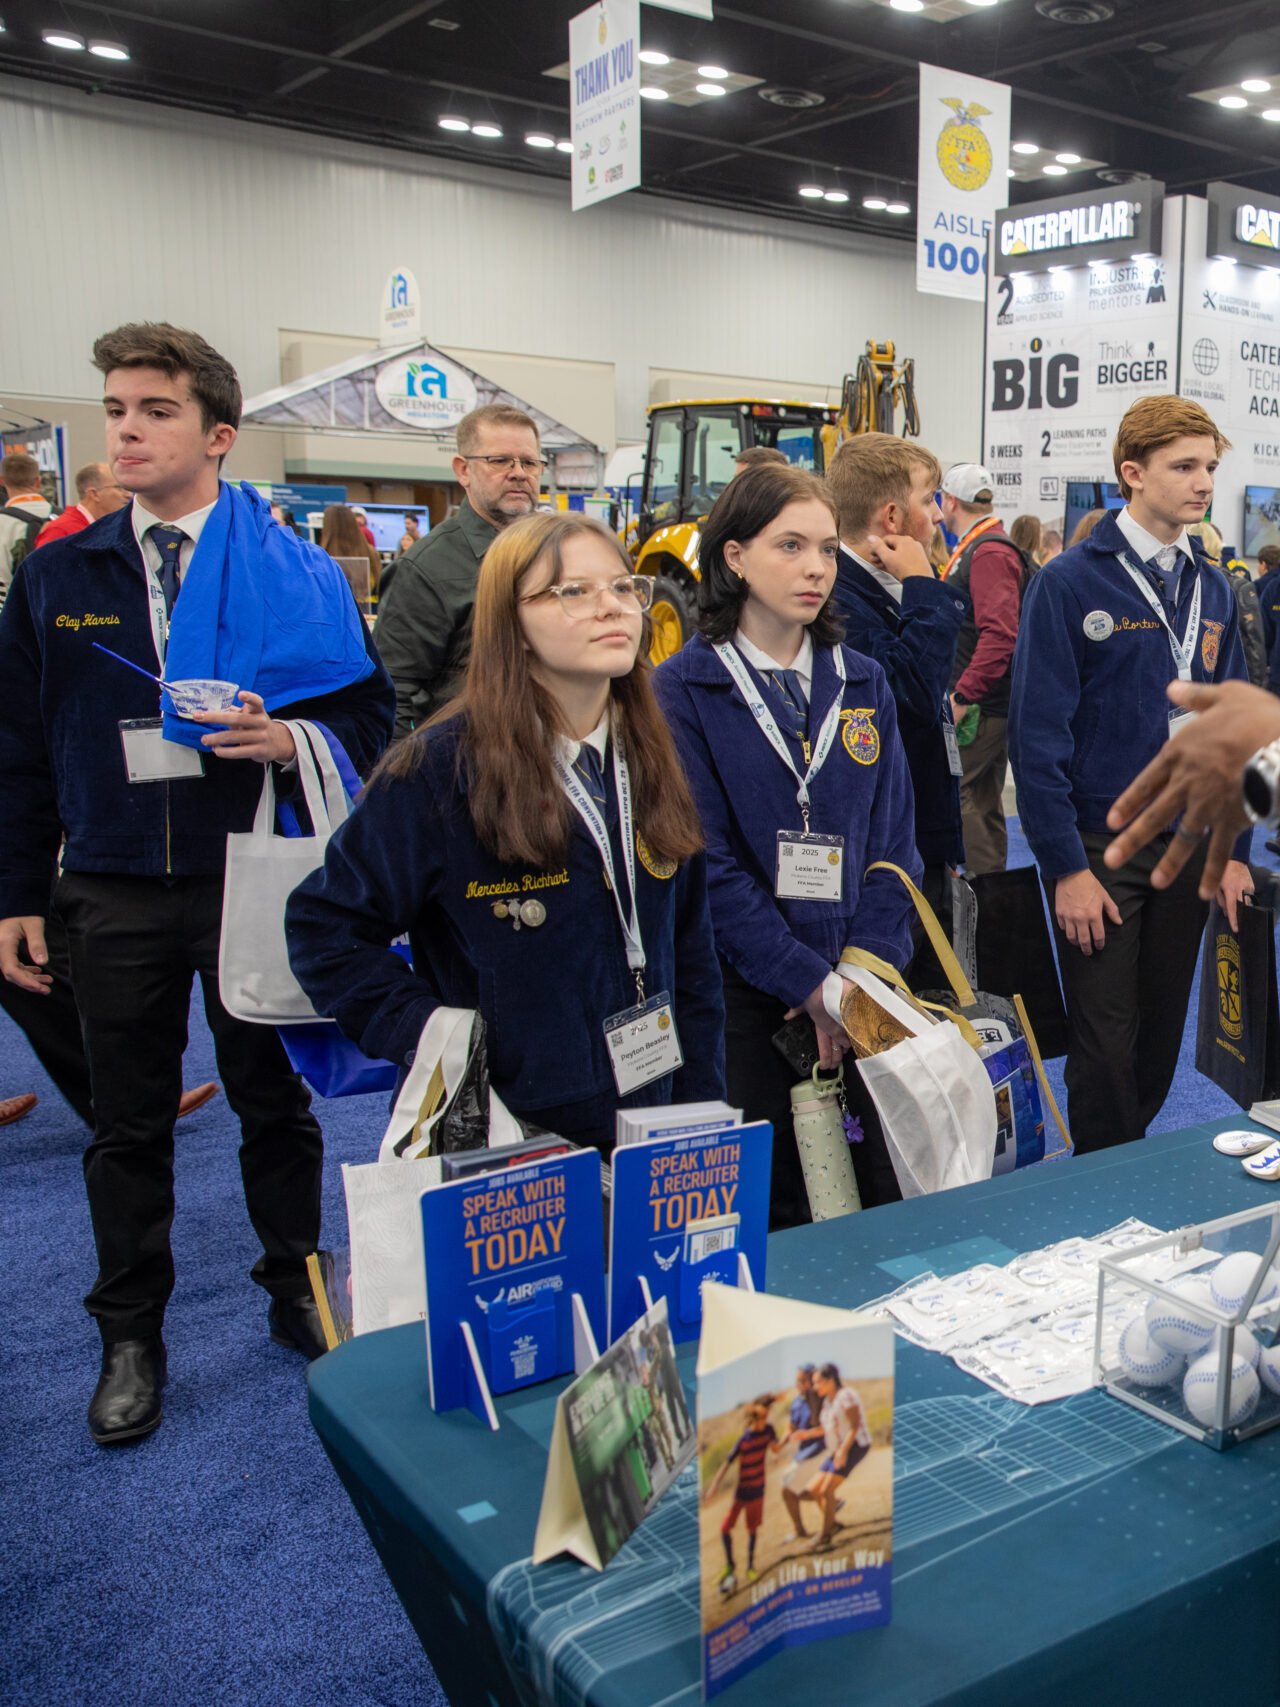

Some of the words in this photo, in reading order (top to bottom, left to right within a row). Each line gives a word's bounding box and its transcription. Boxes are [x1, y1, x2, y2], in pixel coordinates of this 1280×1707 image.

[575, 51, 610, 106] THANK
[611, 38, 634, 87] YOU
[575, 112, 602, 132] PLATINUM
[604, 96, 635, 116] PARTNERS
[954, 137, 977, 152] FFA
[933, 211, 992, 239] AISLE
[1001, 199, 1134, 256] CATERPILLAR
[1089, 293, 1141, 311] mentors
[1098, 341, 1134, 361] Think
[1097, 360, 1168, 385] BIGGER
[388, 398, 466, 413] GREENHOUSE
[1203, 389, 1225, 401] GLOBAL
[996, 444, 1023, 459] WEEKS
[1041, 430, 1051, 457] 2
[996, 472, 1022, 486] WEEKS
[55, 614, 80, 632] Clay
[81, 612, 120, 626] Harris
[1121, 616, 1160, 630] Porter
[569, 782, 580, 798] FFA
[578, 797, 603, 837] CONVENTION
[801, 848, 819, 856] 2025
[795, 865, 812, 873] Lexie
[465, 881, 520, 899] Mercedes
[620, 1046, 645, 1061] Peyton
[645, 1033, 670, 1050] Beasley
[690, 1135, 719, 1149] AVAILABLE
[650, 1151, 698, 1177] SPEAK
[703, 1143, 741, 1168] WITH
[506, 1167, 540, 1184] AVAILABLE
[649, 1179, 660, 1197] A
[664, 1163, 739, 1194] RECRUITER
[462, 1186, 518, 1218] SPEAK
[522, 1174, 565, 1202] WITH
[649, 1183, 738, 1232] TODAY
[464, 1220, 476, 1239] A
[480, 1196, 565, 1235] RECRUITER
[464, 1216, 566, 1275] TODAY
[507, 1283, 534, 1305] AIR
[779, 1562, 807, 1587] Life
[813, 1556, 848, 1579] Your
[853, 1549, 885, 1570] Way
